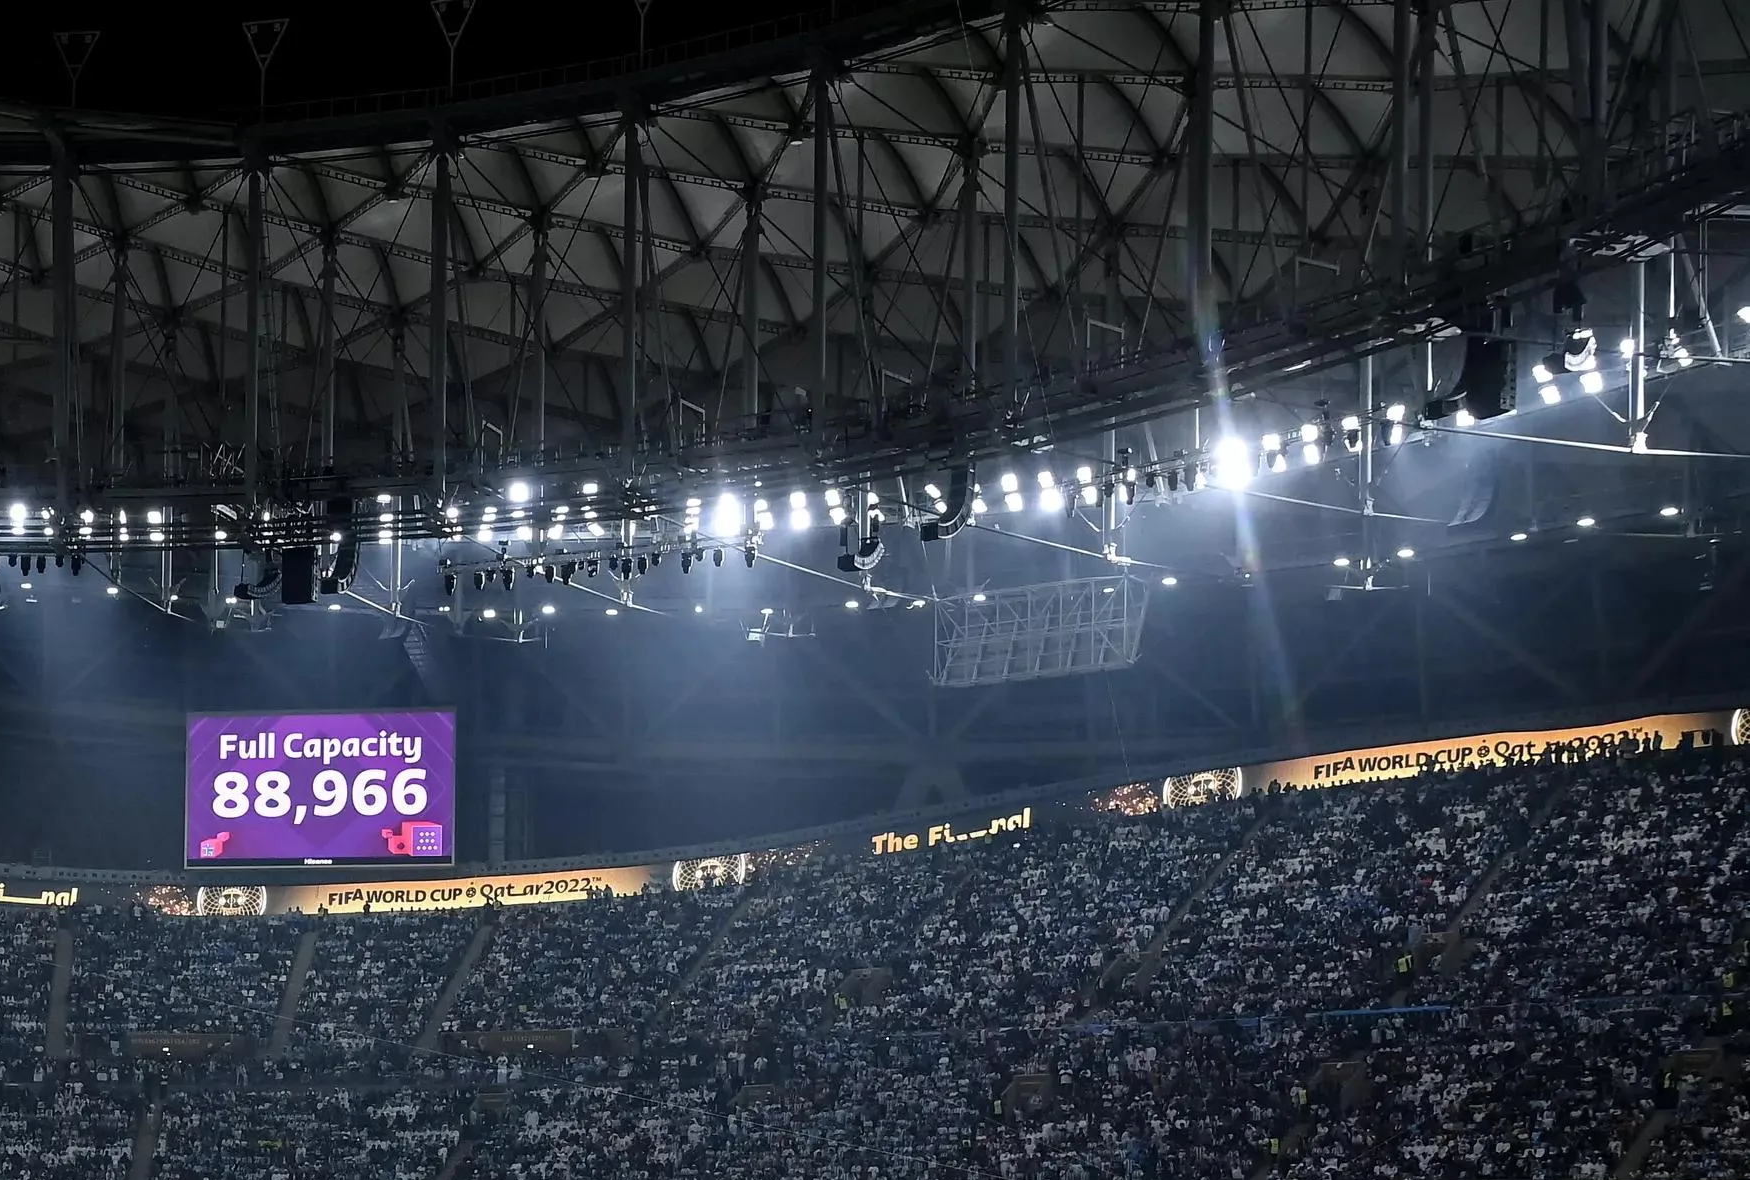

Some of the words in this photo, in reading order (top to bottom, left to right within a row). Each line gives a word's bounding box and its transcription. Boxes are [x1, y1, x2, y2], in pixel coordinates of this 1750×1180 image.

[219, 732, 276, 760] Full
[282, 730, 423, 765] Capacity
[1313, 757, 1355, 779] FIFA
[1358, 752, 1432, 772] WORLD
[1434, 746, 1473, 765] CUP
[212, 768, 428, 825] 88,966
[871, 831, 919, 855] The
[328, 888, 364, 906] FIFA
[366, 890, 427, 904] WORLD
[430, 887, 463, 902] CUP
